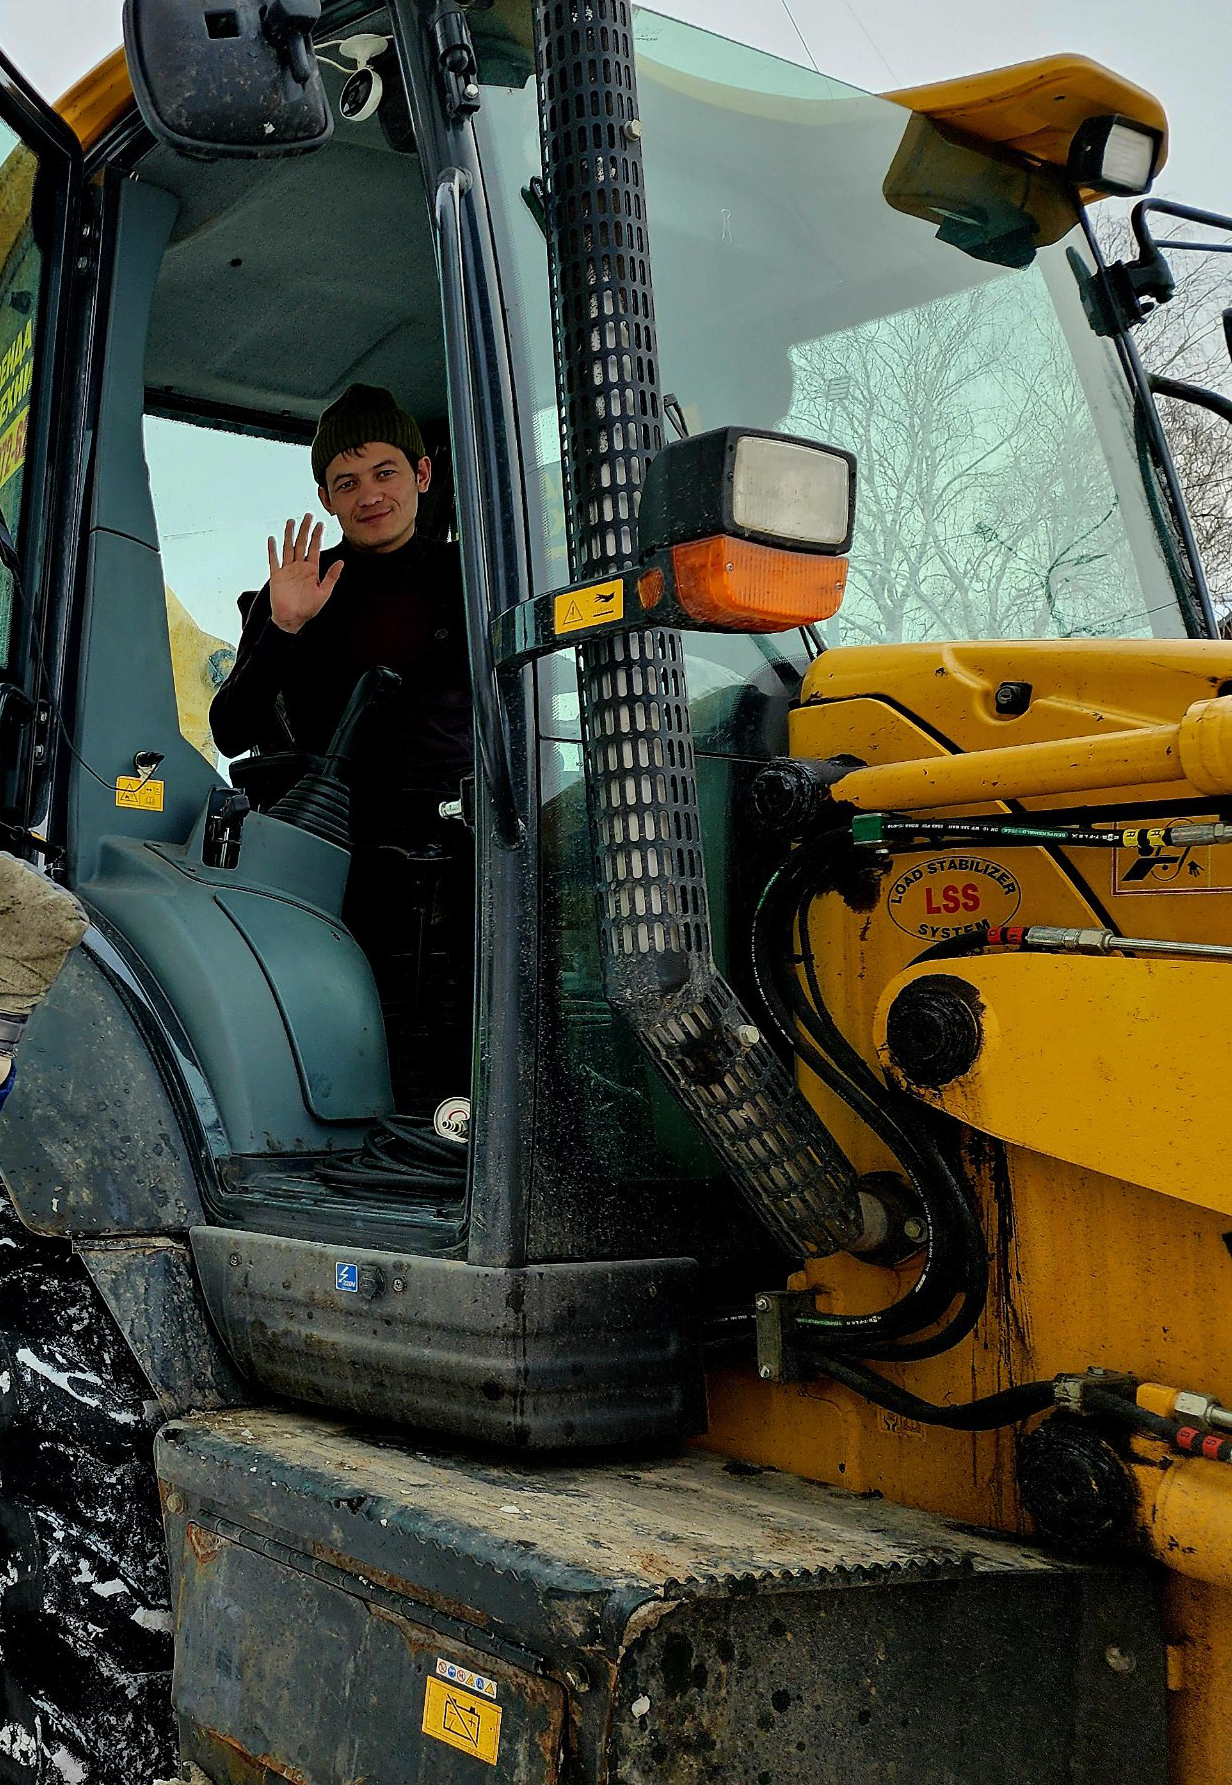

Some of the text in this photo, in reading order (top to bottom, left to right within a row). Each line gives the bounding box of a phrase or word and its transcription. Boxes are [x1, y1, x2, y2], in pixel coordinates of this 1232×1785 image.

[891, 859, 1016, 904] LOAD STABILIZER
[925, 883, 981, 915] LSS
[918, 918, 991, 939] SYSTEM
